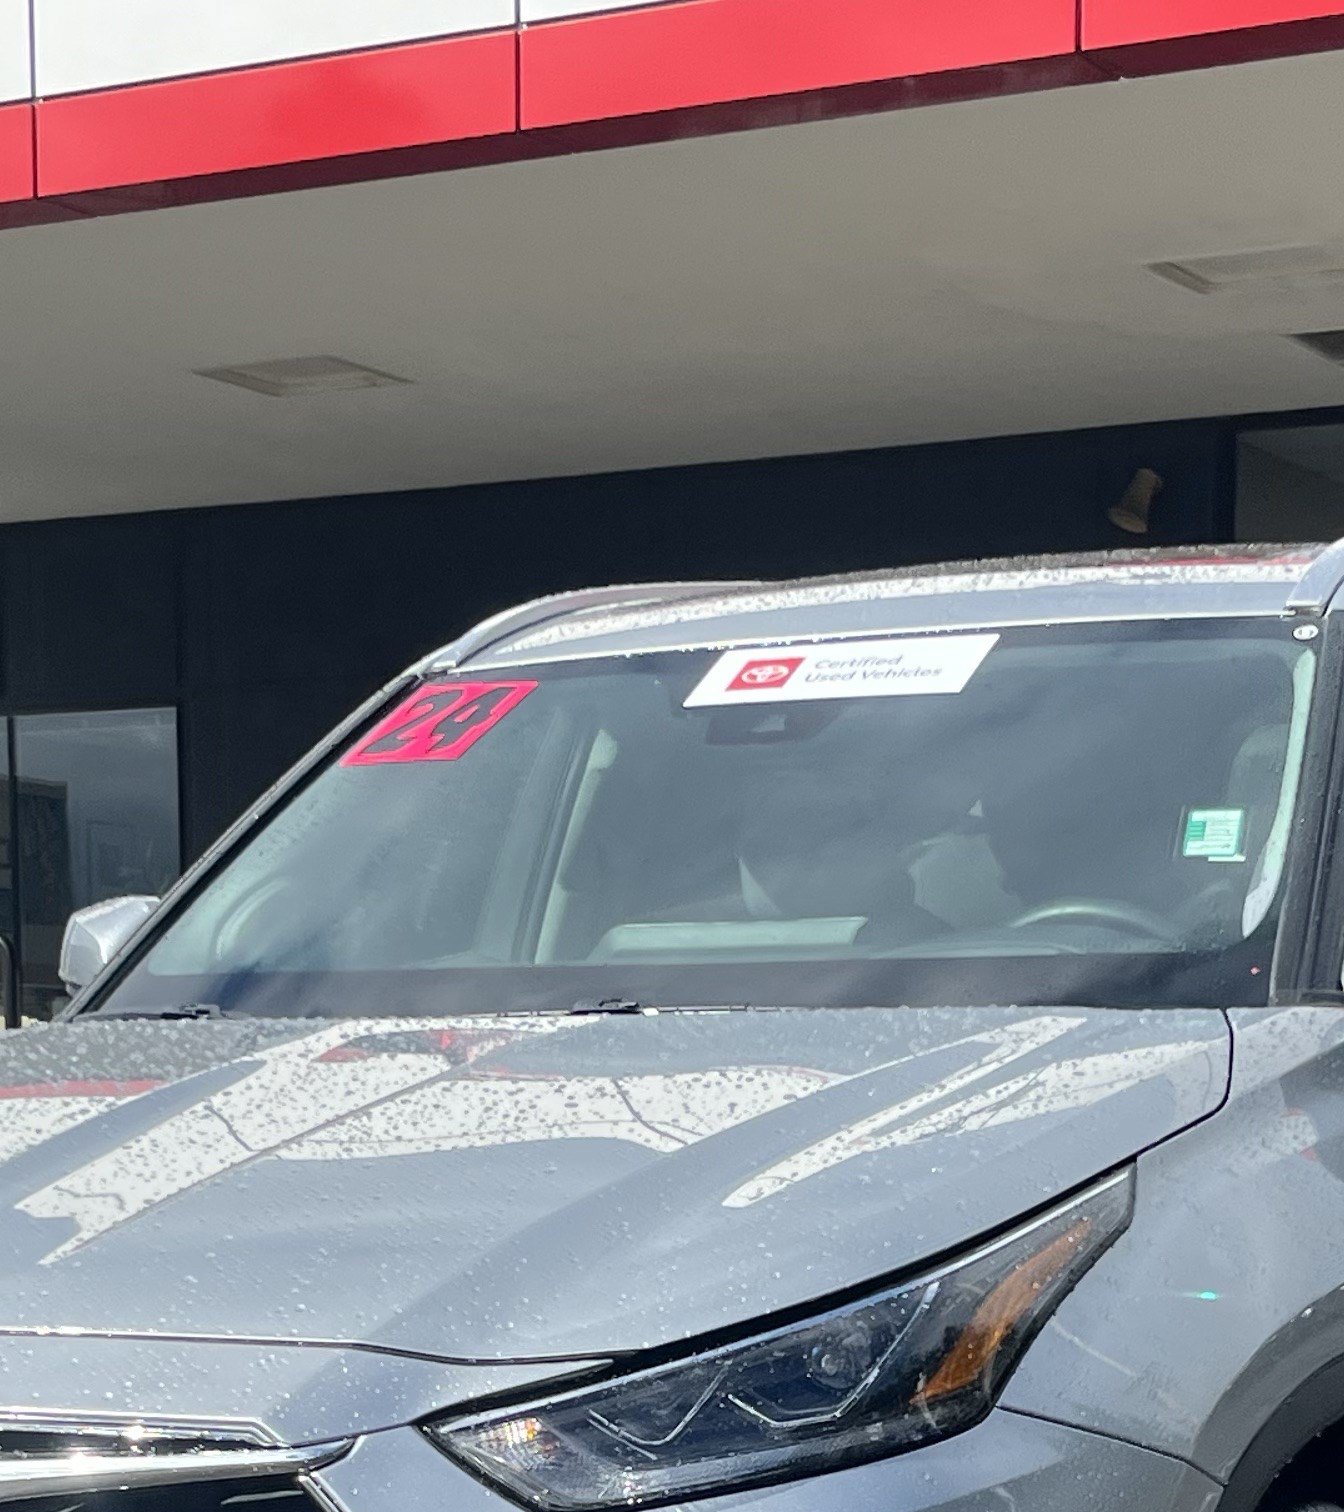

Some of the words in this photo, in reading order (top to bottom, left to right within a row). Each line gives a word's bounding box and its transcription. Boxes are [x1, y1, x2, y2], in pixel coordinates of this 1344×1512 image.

[814, 654, 904, 670] Certified
[804, 670, 855, 684] Used
[861, 666, 943, 680] Vehicles
[358, 687, 518, 754] 24
